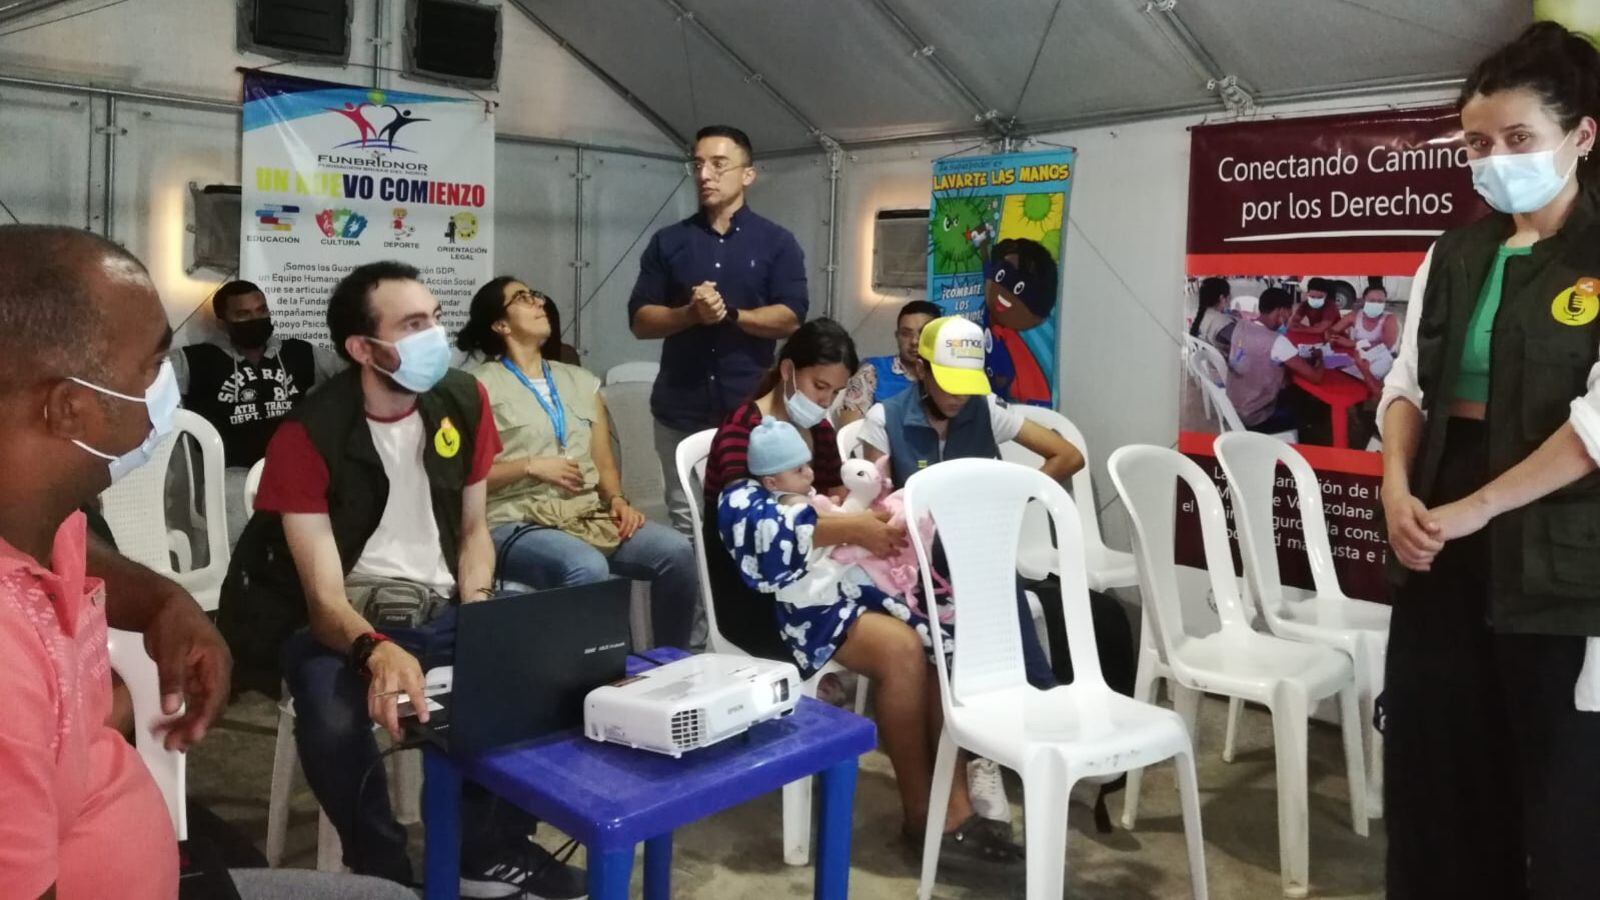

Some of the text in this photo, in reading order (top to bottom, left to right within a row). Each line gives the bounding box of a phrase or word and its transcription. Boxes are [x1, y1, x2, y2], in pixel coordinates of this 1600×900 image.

[317, 154, 428, 172] FUNBRIDNOR
[1218, 145, 1470, 182] Conectando Camino
[933, 163, 1070, 191] LAVARTE LAS MANOS
[256, 166, 290, 193] UN
[380, 177, 485, 207] COMIENZO
[1241, 187, 1454, 228] por los Derechos
[320, 238, 361, 247] CULTURA
[383, 241, 420, 249] DEPORTE
[317, 263, 330, 272] los
[272, 273, 302, 284] Equipo
[454, 278, 476, 286] Social
[295, 286, 329, 294] articula
[276, 297, 288, 306] de
[290, 297, 298, 305] la
[439, 299, 461, 307] rindar
[954, 300, 969, 311] LOS
[270, 307, 328, 318] ompañamien
[272, 320, 301, 330] Apoyo
[273, 331, 329, 340] omunidades
[234, 401, 293, 416] ATH TRACK
[1349, 483, 1369, 499] de
[1182, 499, 1195, 513] el
[1366, 551, 1376, 563] e
